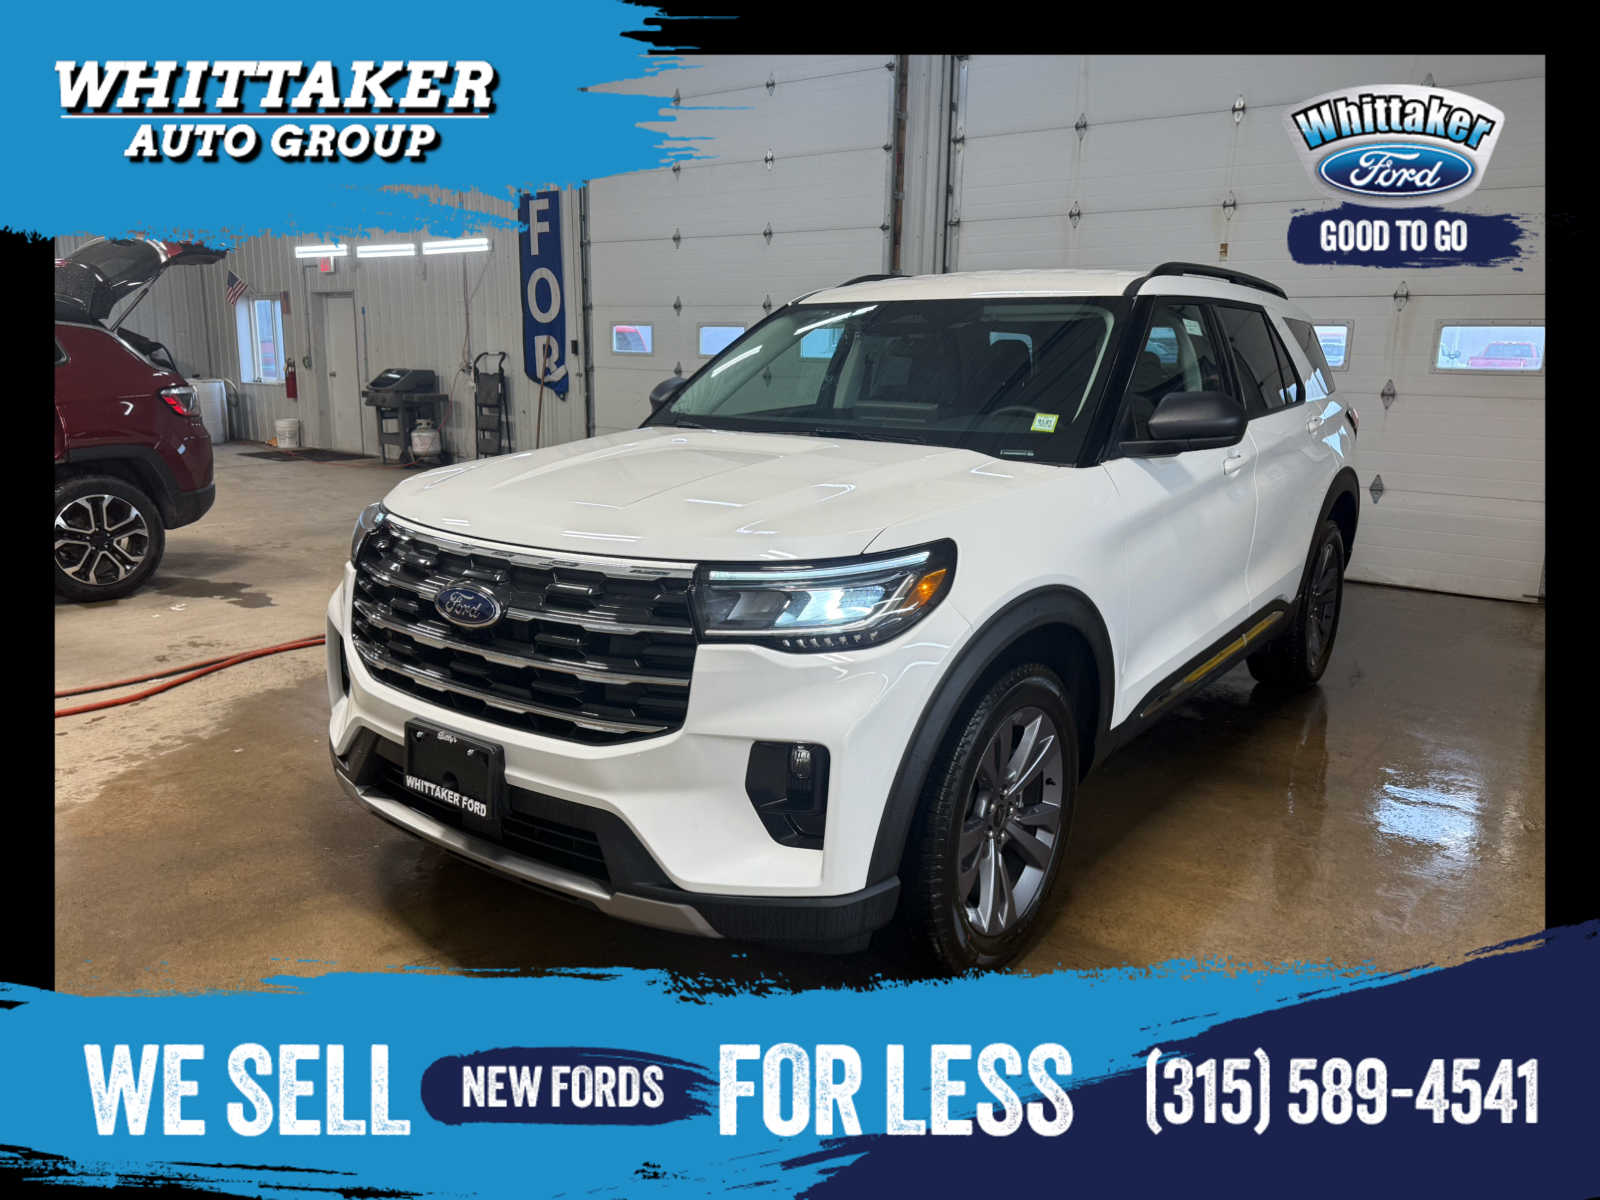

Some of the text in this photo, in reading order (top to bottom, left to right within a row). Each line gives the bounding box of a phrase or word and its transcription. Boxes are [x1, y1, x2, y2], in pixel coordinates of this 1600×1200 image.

[445, 591, 482, 618] Ford
[406, 775, 487, 817] WHITTAKER FORD
